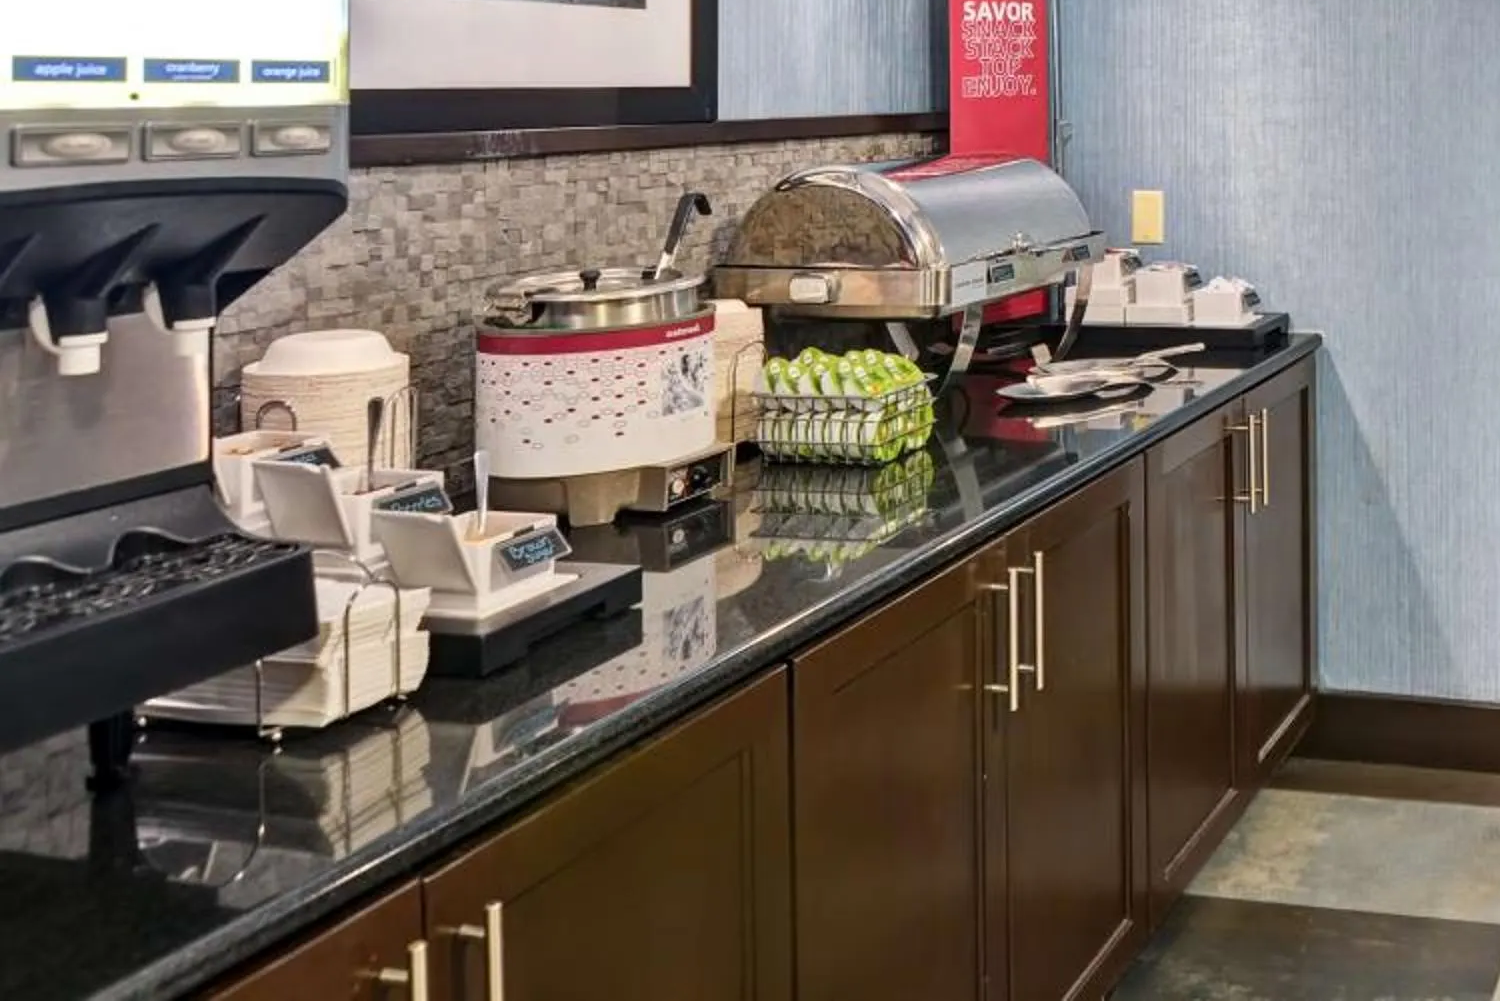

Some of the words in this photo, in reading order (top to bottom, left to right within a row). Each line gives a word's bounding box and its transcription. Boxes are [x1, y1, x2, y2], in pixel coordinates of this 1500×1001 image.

[962, 0, 1035, 22] SAVOR
[961, 19, 1036, 40] SNACK
[964, 37, 1035, 60] STACK
[34, 62, 74, 78] apple
[76, 62, 107, 79] juice
[164, 62, 221, 79] cranberry
[262, 66, 297, 79] orange
[299, 66, 321, 78] juice
[979, 56, 1022, 78] TOP
[961, 75, 1038, 98] ENJOY.
